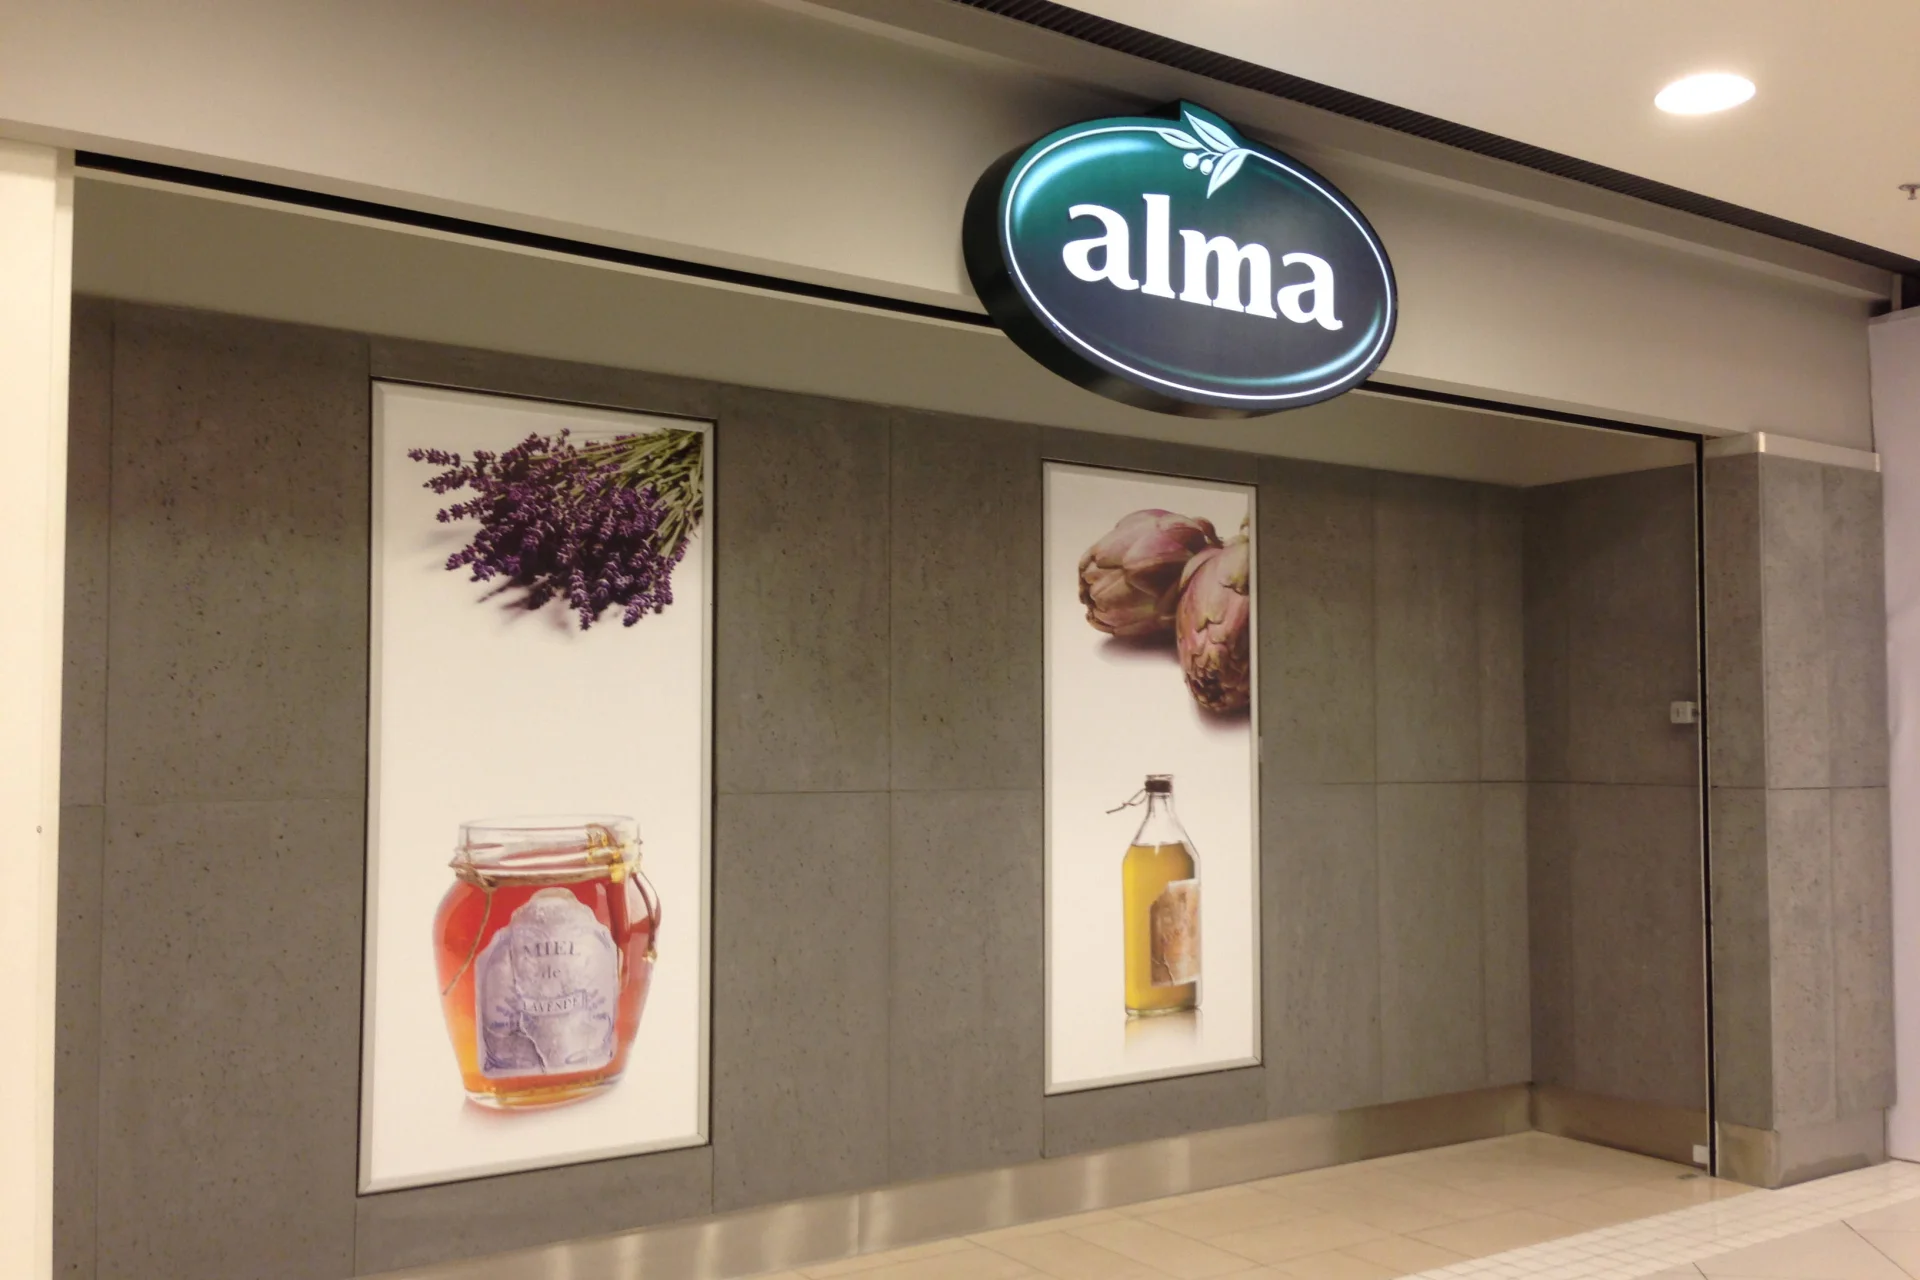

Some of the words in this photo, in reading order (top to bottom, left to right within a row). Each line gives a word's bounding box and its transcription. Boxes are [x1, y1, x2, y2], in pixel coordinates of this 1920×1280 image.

[1062, 193, 1344, 331] alma
[522, 940, 582, 959] MIEL
[541, 965, 561, 980] de
